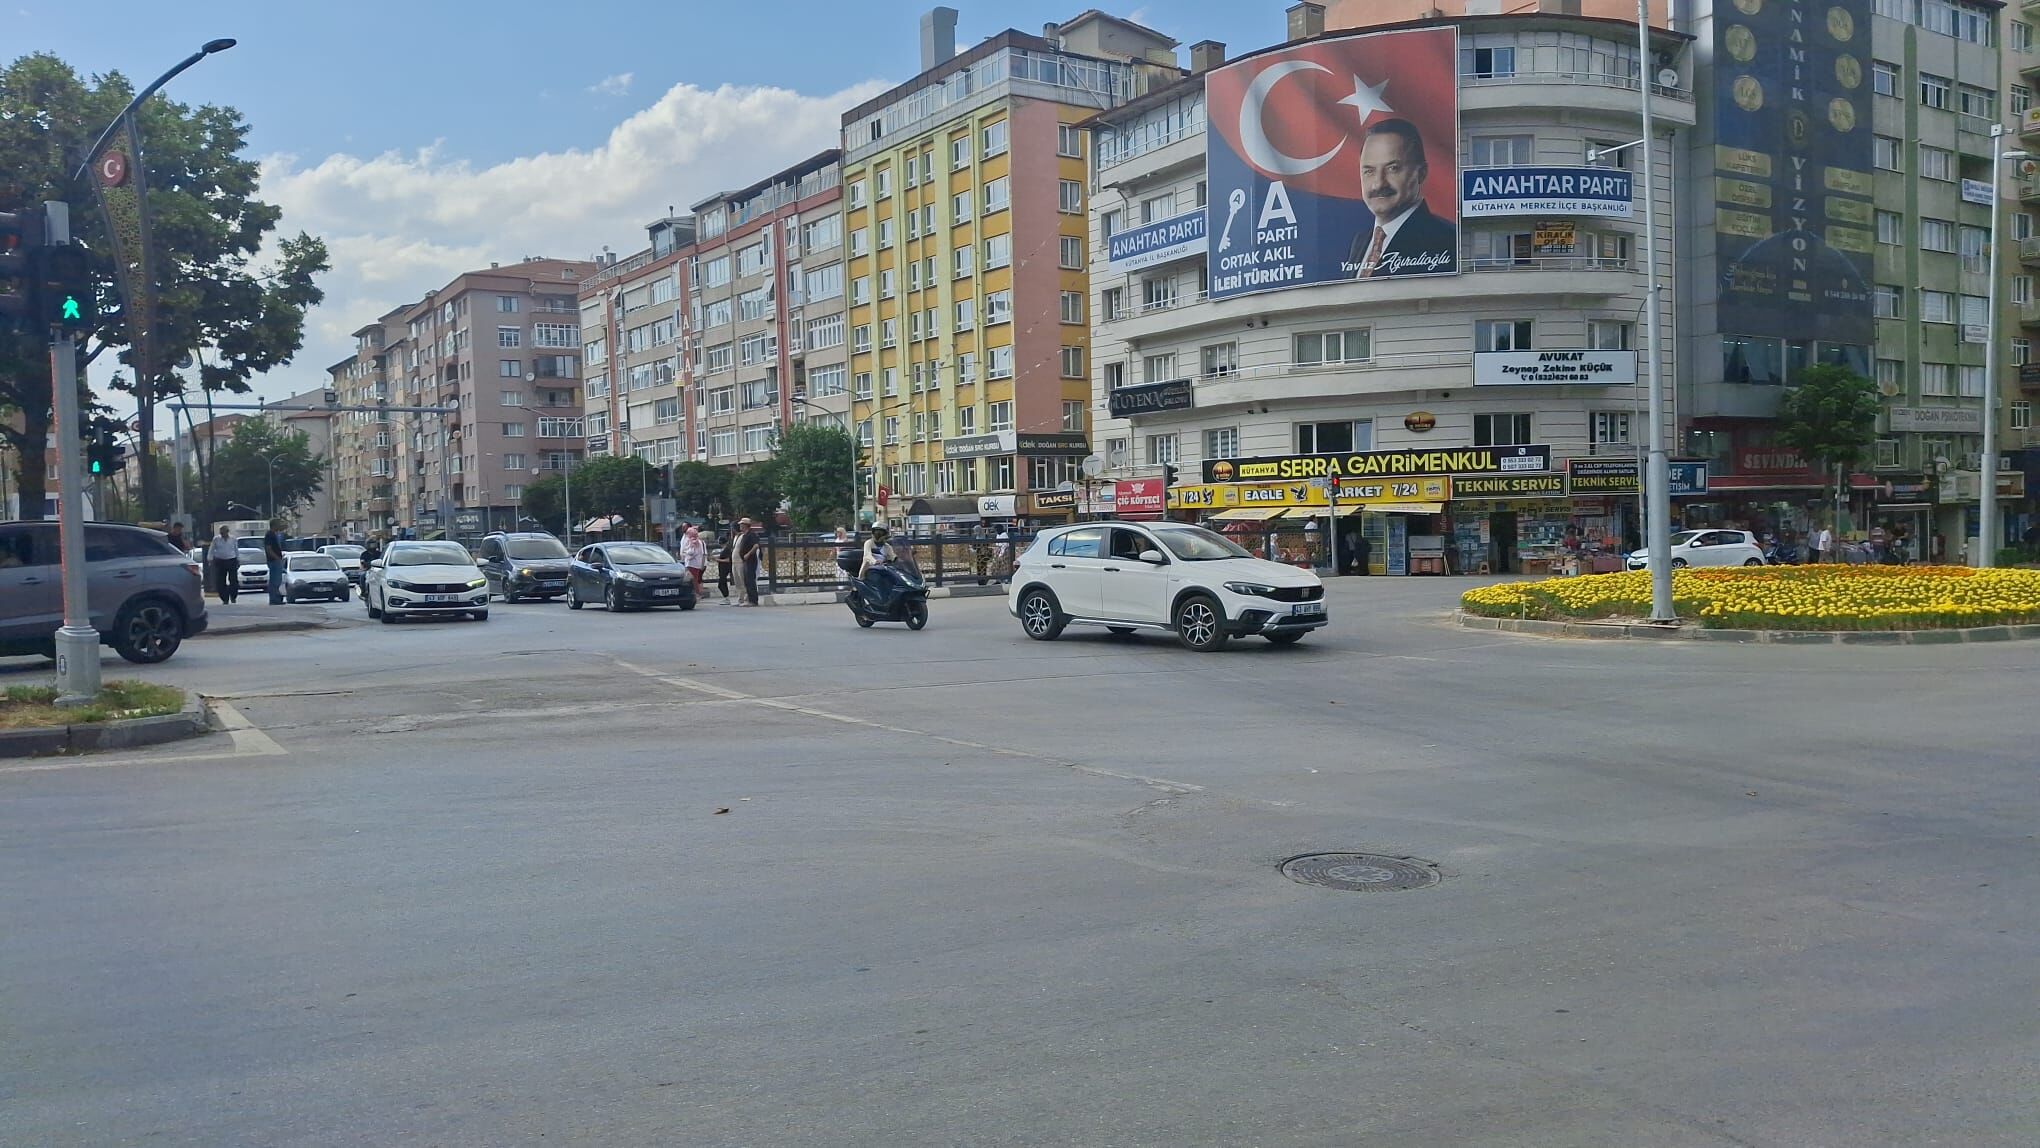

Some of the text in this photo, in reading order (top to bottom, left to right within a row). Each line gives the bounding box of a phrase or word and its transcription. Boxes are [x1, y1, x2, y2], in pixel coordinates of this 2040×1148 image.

[1790, 0, 1805, 101] NAMİK
[1471, 175, 1628, 197] ANAHTAR PARTİ
[1257, 180, 1297, 229] A
[1471, 200, 1627, 212] KÜTAHYA MERKEZ İLÇE BAŞKANLIĞI
[1791, 156, 1807, 271] VİZYON
[1112, 216, 1204, 258] ANAHTAR PARTİ
[1257, 226, 1298, 245] PARTİ
[1220, 247, 1296, 271] ORTAK AKIL
[1340, 260, 1375, 272] Yavuz
[1214, 264, 1304, 292] İLERİ TÜRKİYE
[682, 314, 691, 373] ATA
[1538, 352, 1585, 361] AVUKAT
[1502, 363, 1613, 375] Zeynep Zekine KÜÇÜK
[1241, 466, 1276, 476] KÜTAHYA
[1280, 451, 1498, 478] SERRA GAYRİMENKUL
[1455, 478, 1509, 493] TEKNİK
[1511, 475, 1561, 491] SERVİS
[1571, 475, 1607, 487] TEKNİK
[1182, 490, 1200, 504] 7/24
[1243, 488, 1285, 501] EAGLE
[1323, 486, 1383, 499] MARKET
[1391, 483, 1418, 497] 7/24
[983, 500, 1000, 511] dek
[1131, 494, 1161, 505] KÖFTECİ
